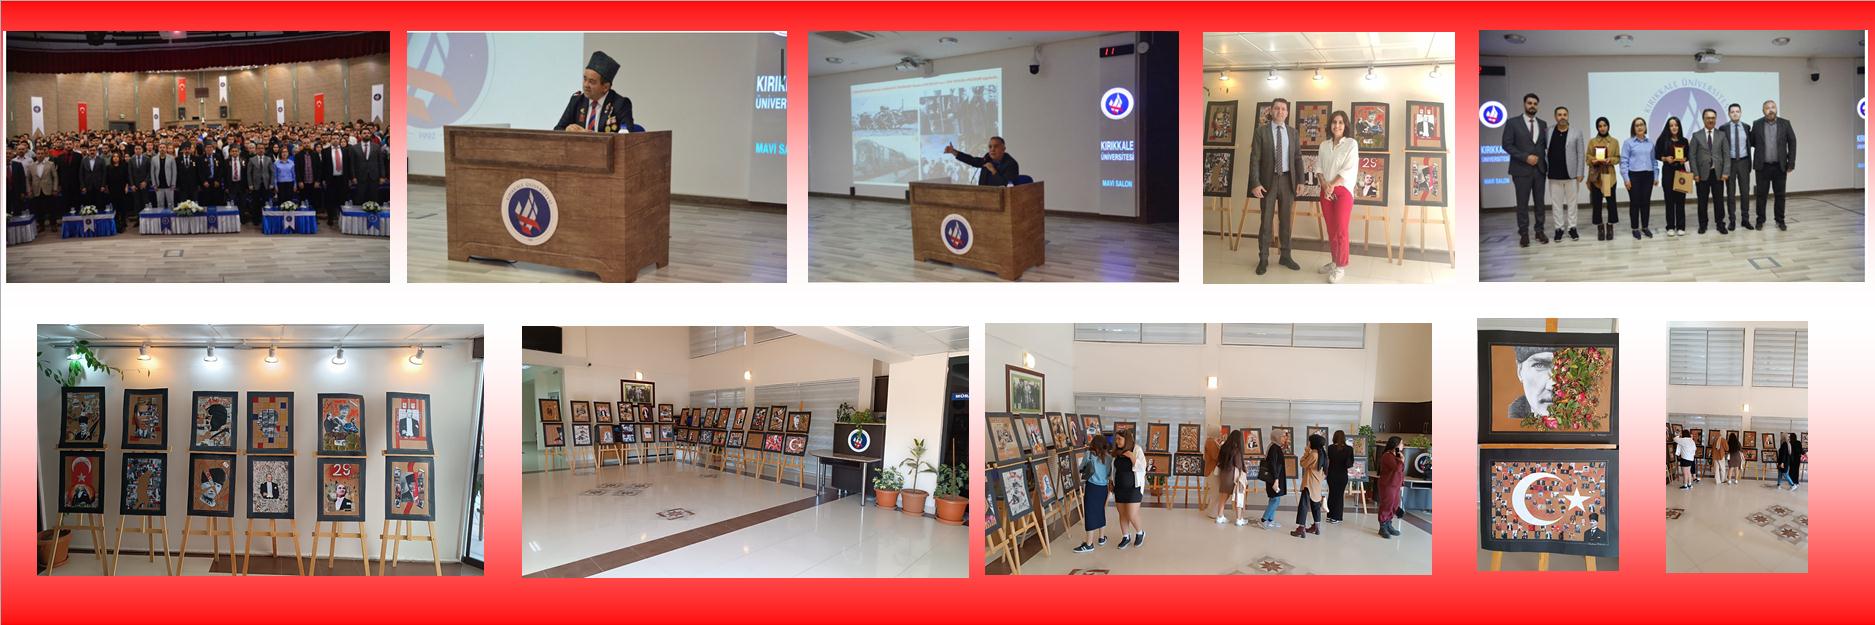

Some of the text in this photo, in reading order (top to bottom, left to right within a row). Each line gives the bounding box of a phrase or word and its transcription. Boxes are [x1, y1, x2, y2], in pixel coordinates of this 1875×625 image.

[756, 75, 787, 92] KIRIK
[1101, 140, 1134, 150] KIRIKKALE
[333, 463, 351, 476] 29
